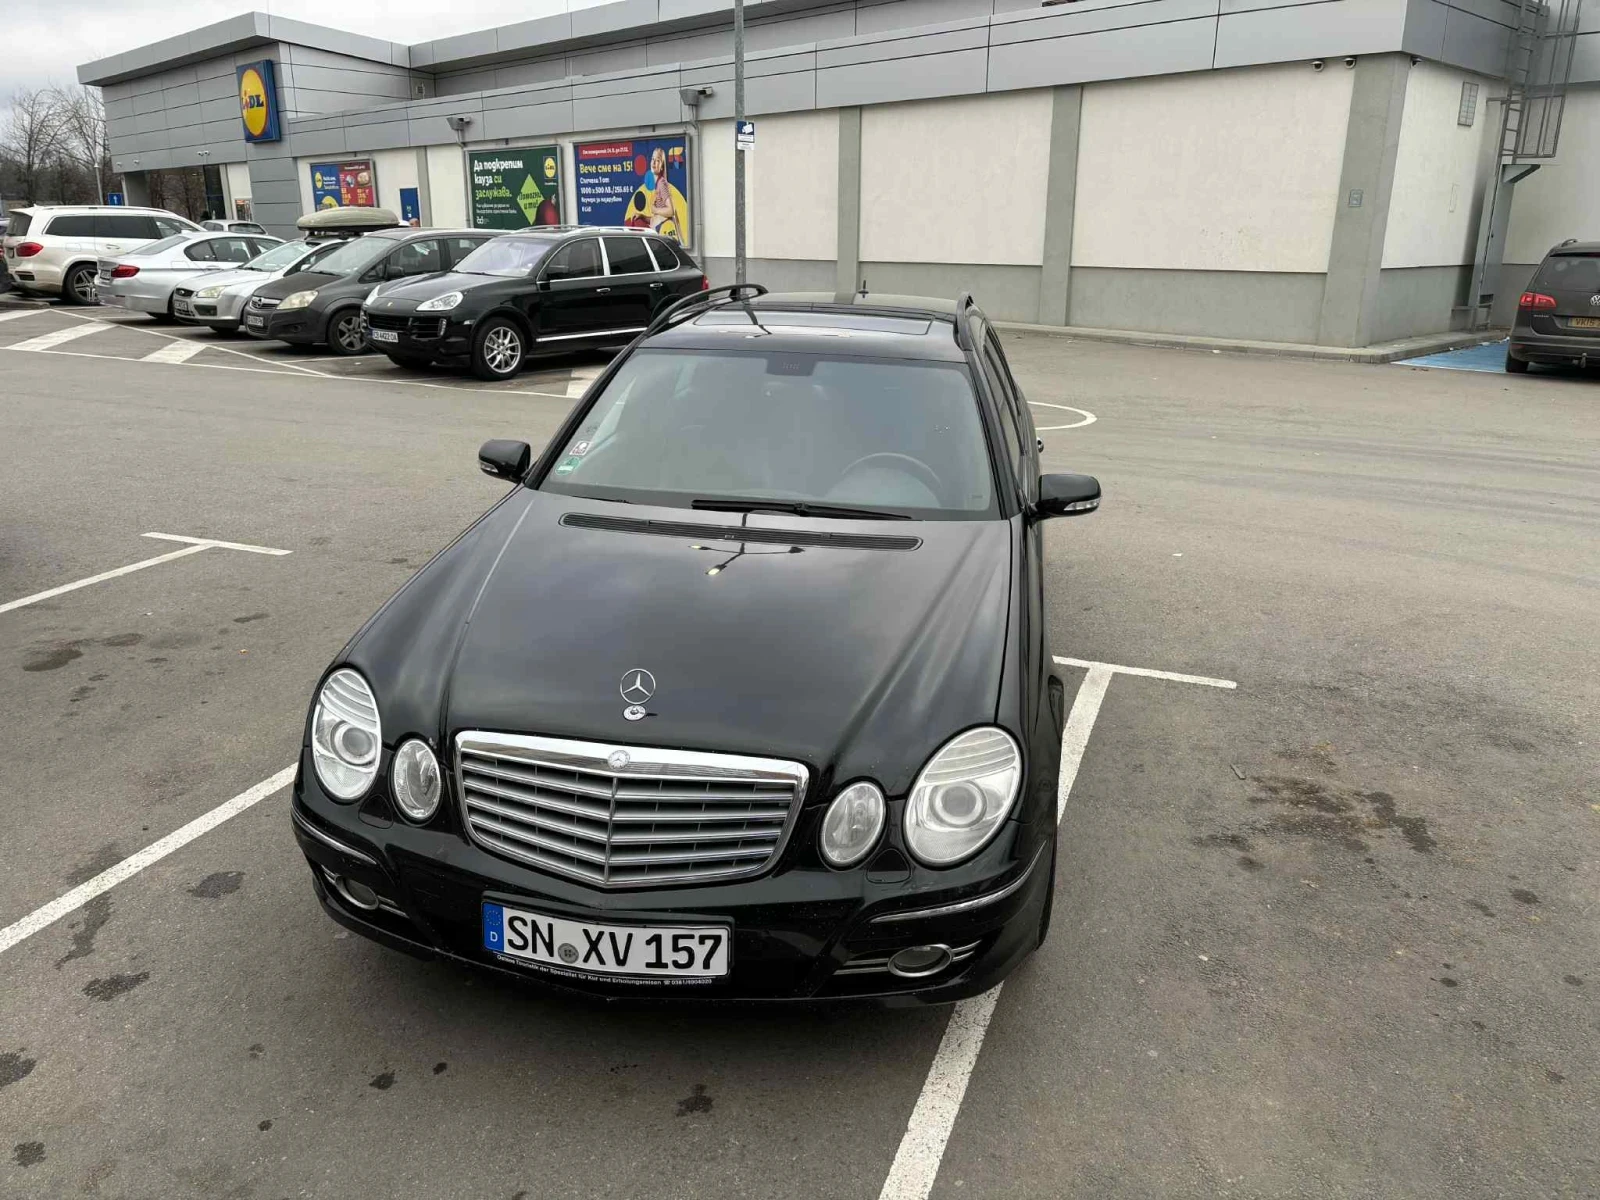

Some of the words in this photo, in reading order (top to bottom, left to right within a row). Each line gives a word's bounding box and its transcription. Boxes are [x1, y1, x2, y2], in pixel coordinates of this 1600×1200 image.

[474, 160, 483, 172] Да
[579, 164, 597, 174] Вече
[597, 164, 612, 173] сме
[612, 164, 622, 172] на
[623, 161, 633, 172] 15!
[475, 174, 493, 186] кауза
[490, 931, 498, 942] D
[507, 915, 554, 958] SN
[582, 928, 633, 967] XV
[645, 933, 723, 970] 157
